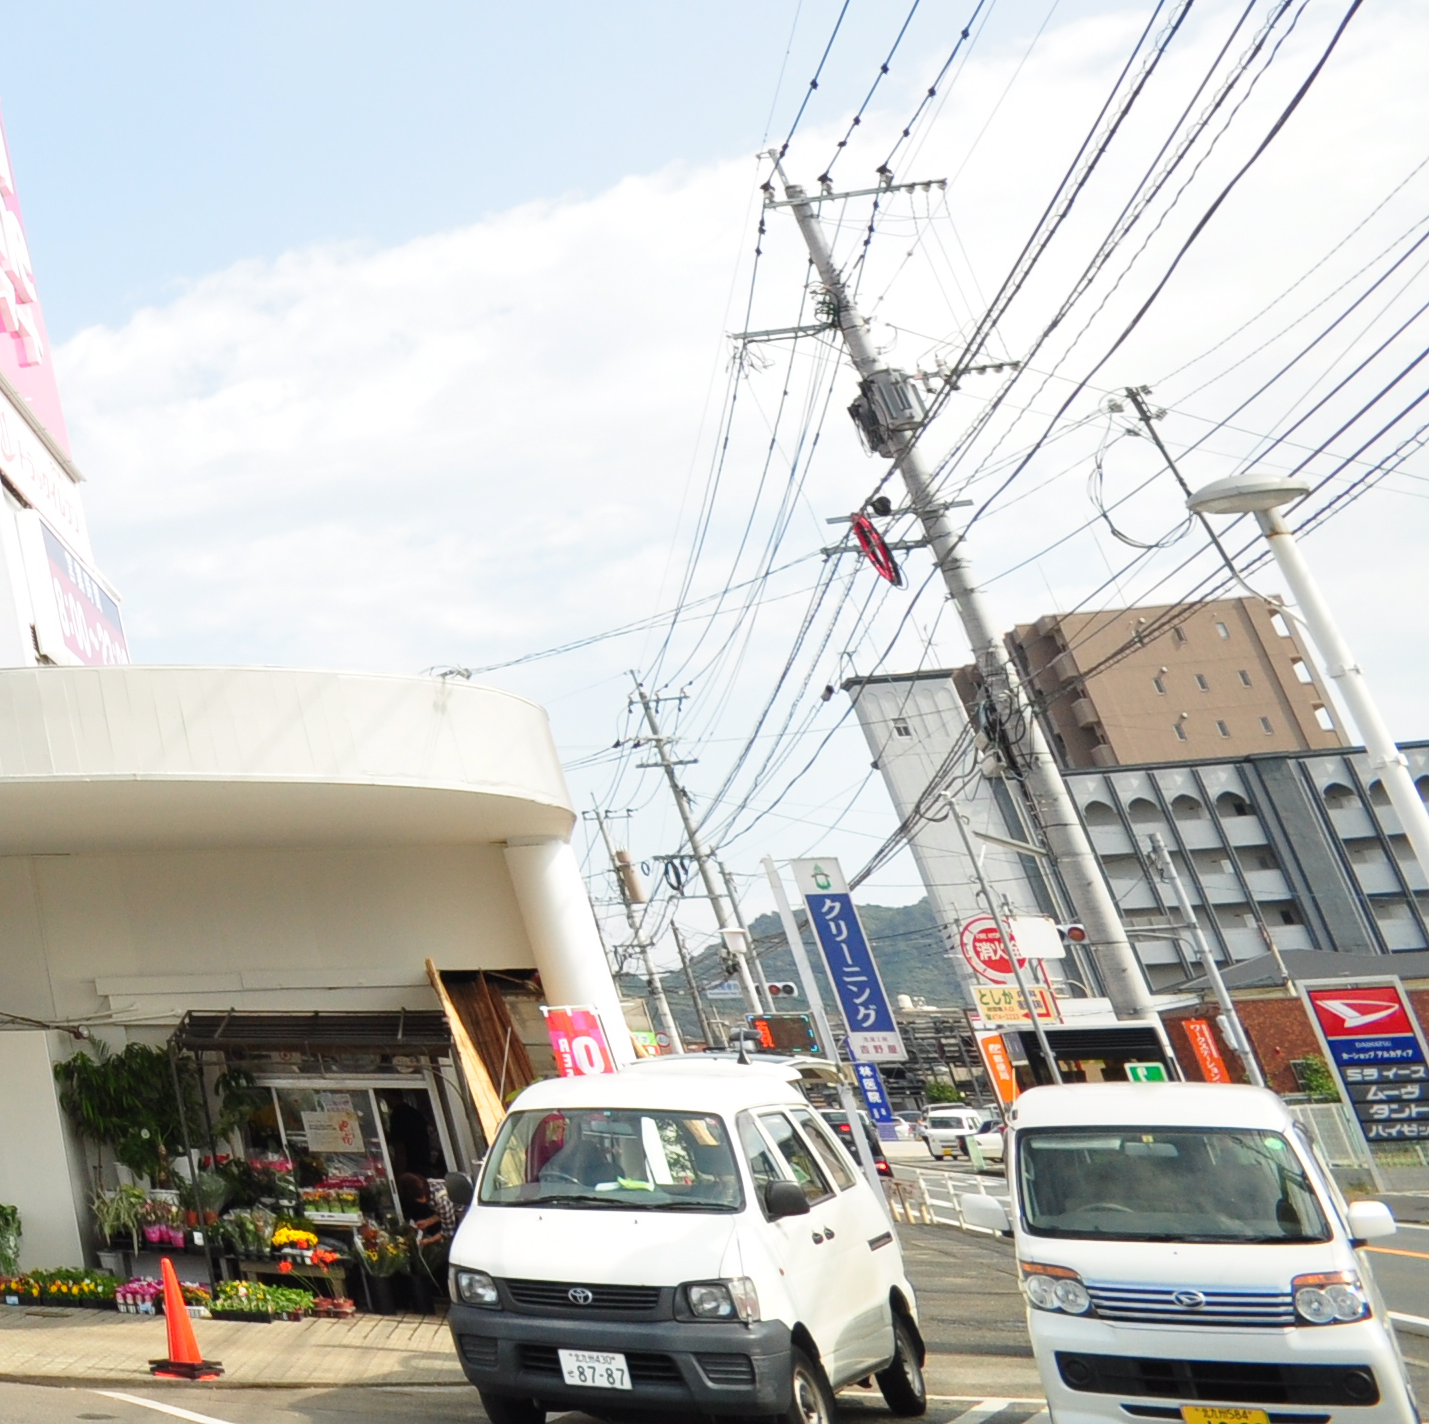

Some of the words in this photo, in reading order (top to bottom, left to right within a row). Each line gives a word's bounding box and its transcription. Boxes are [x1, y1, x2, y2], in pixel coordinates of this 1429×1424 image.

[821, 898, 877, 1028] クリーニング
[1366, 1084, 1420, 1100] ムーヴ
[1369, 1104, 1429, 1119] タント
